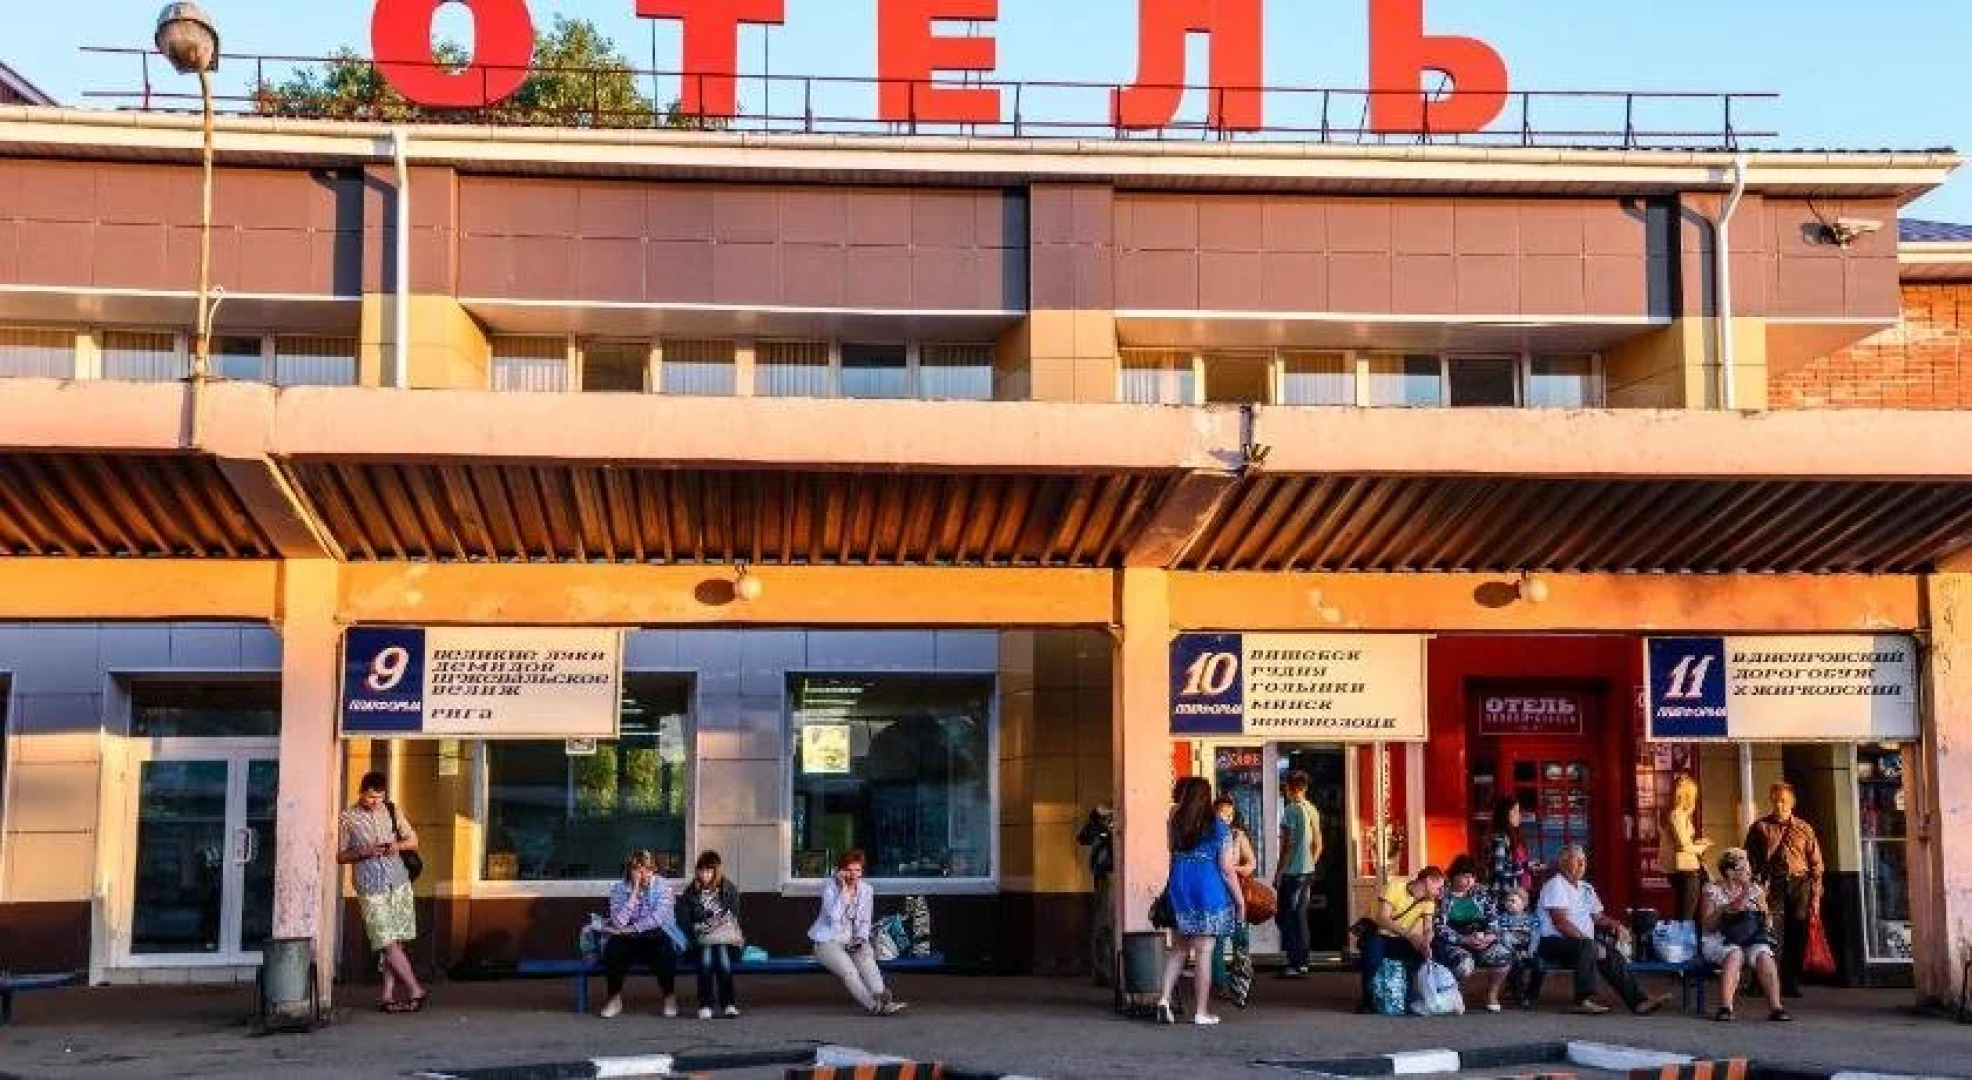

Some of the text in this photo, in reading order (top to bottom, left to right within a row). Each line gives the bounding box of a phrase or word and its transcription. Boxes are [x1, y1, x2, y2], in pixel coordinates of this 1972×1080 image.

[370, 0, 1508, 133] ОТЕЛЬ
[368, 646, 410, 691] 9
[1180, 651, 1238, 696] 10
[1664, 654, 1716, 698] 11
[1484, 696, 1576, 714] ОТЕЛЬ
